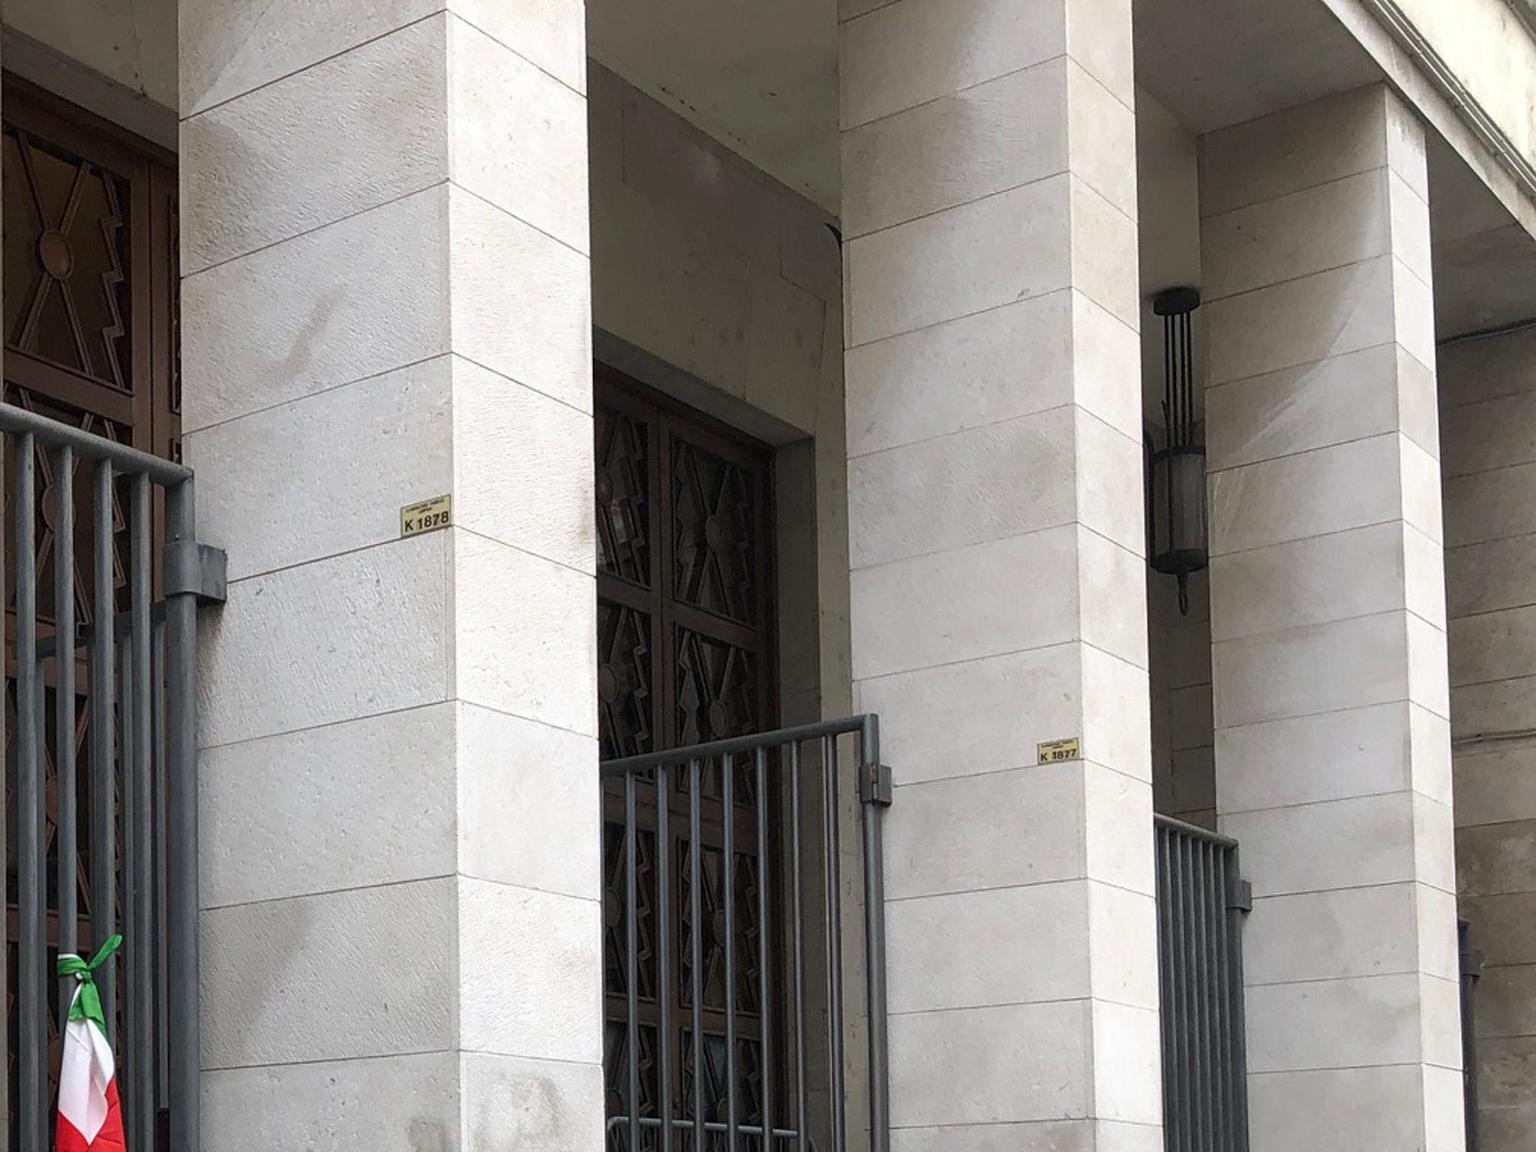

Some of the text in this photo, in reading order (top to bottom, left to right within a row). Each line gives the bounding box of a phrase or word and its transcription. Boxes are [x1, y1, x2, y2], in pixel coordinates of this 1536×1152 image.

[404, 511, 449, 532] K 1878
[1040, 748, 1076, 761] K 1877
